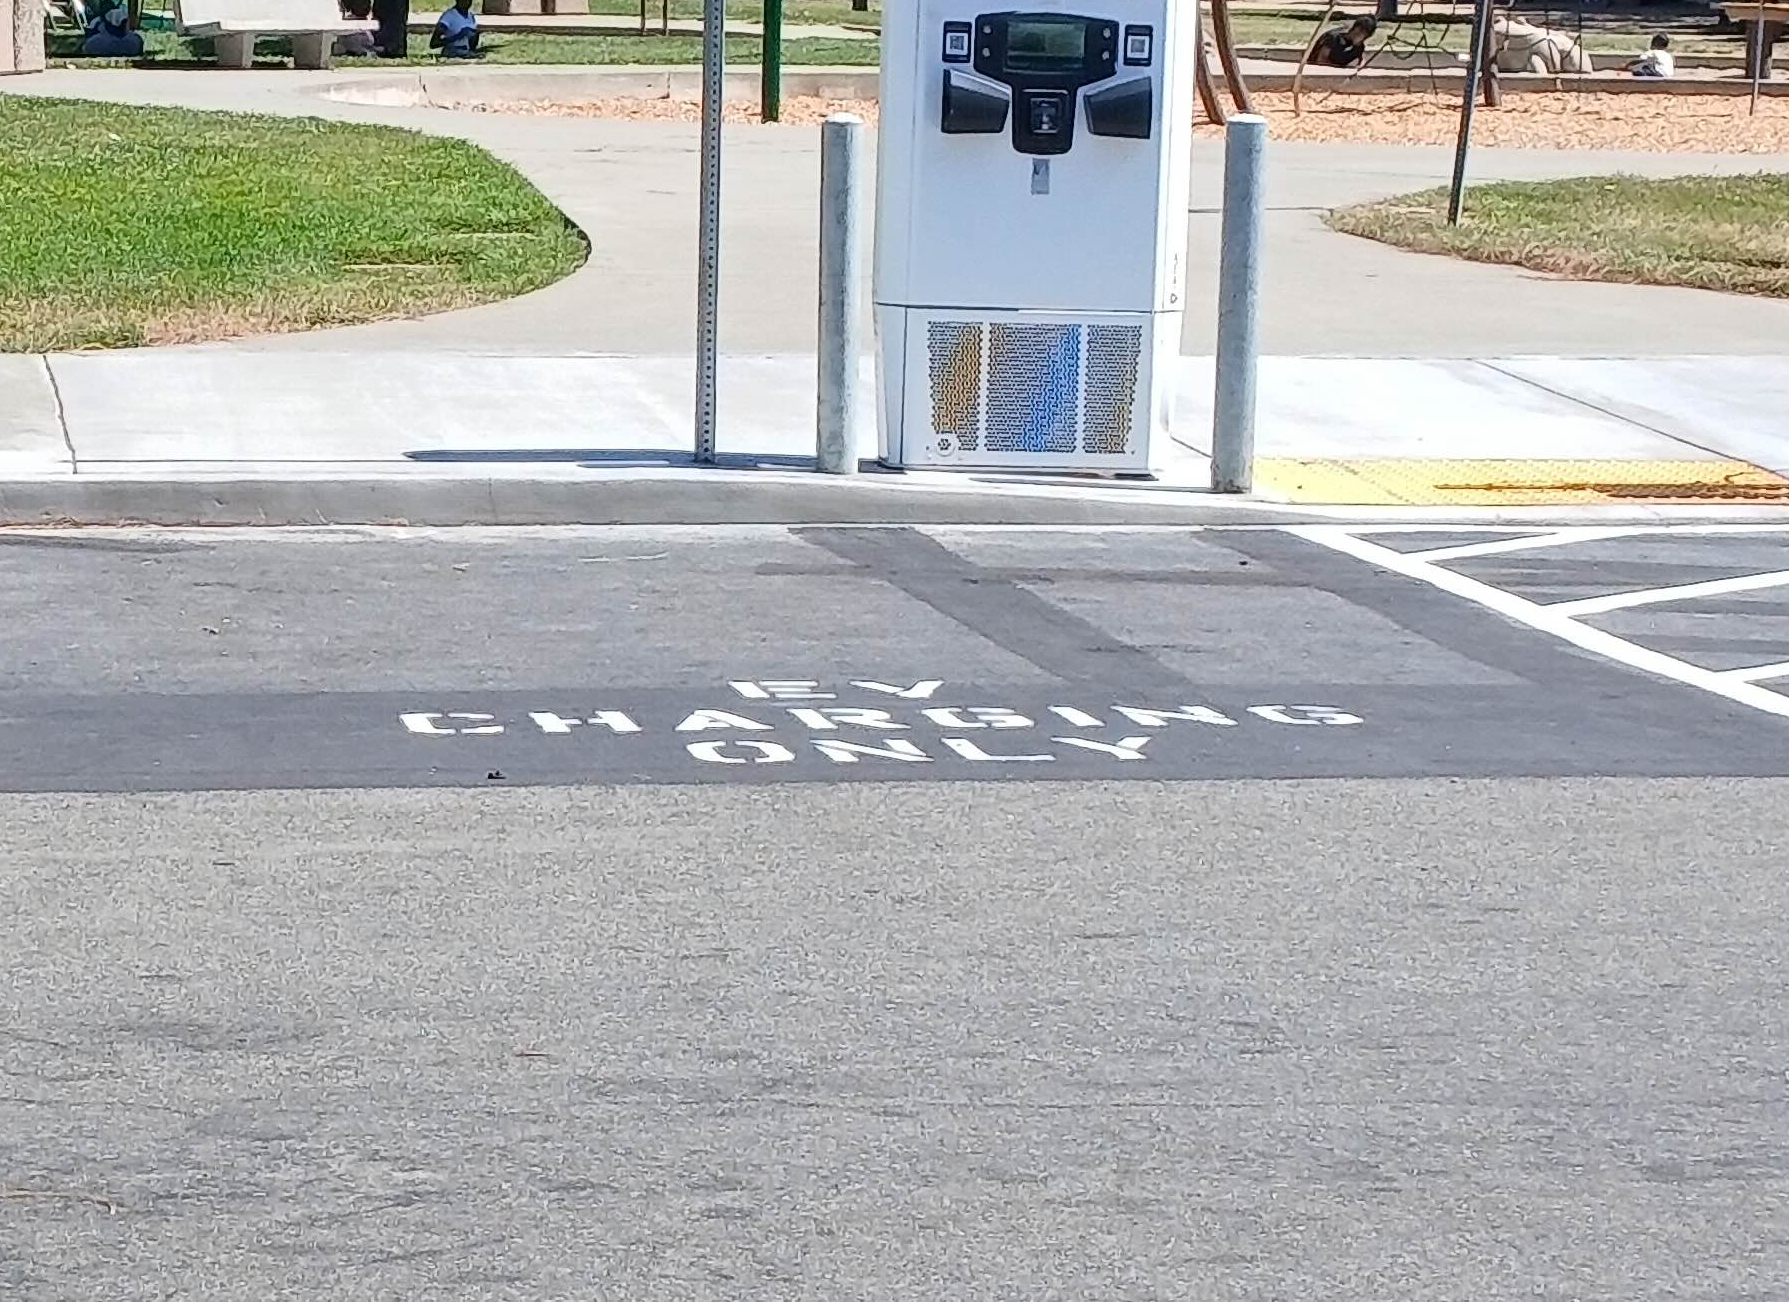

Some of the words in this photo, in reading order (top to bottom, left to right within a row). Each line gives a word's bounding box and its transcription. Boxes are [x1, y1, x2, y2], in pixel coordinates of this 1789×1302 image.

[728, 680, 944, 699] EV
[399, 704, 1364, 734] CHARGING
[686, 736, 1152, 763] ONLY
